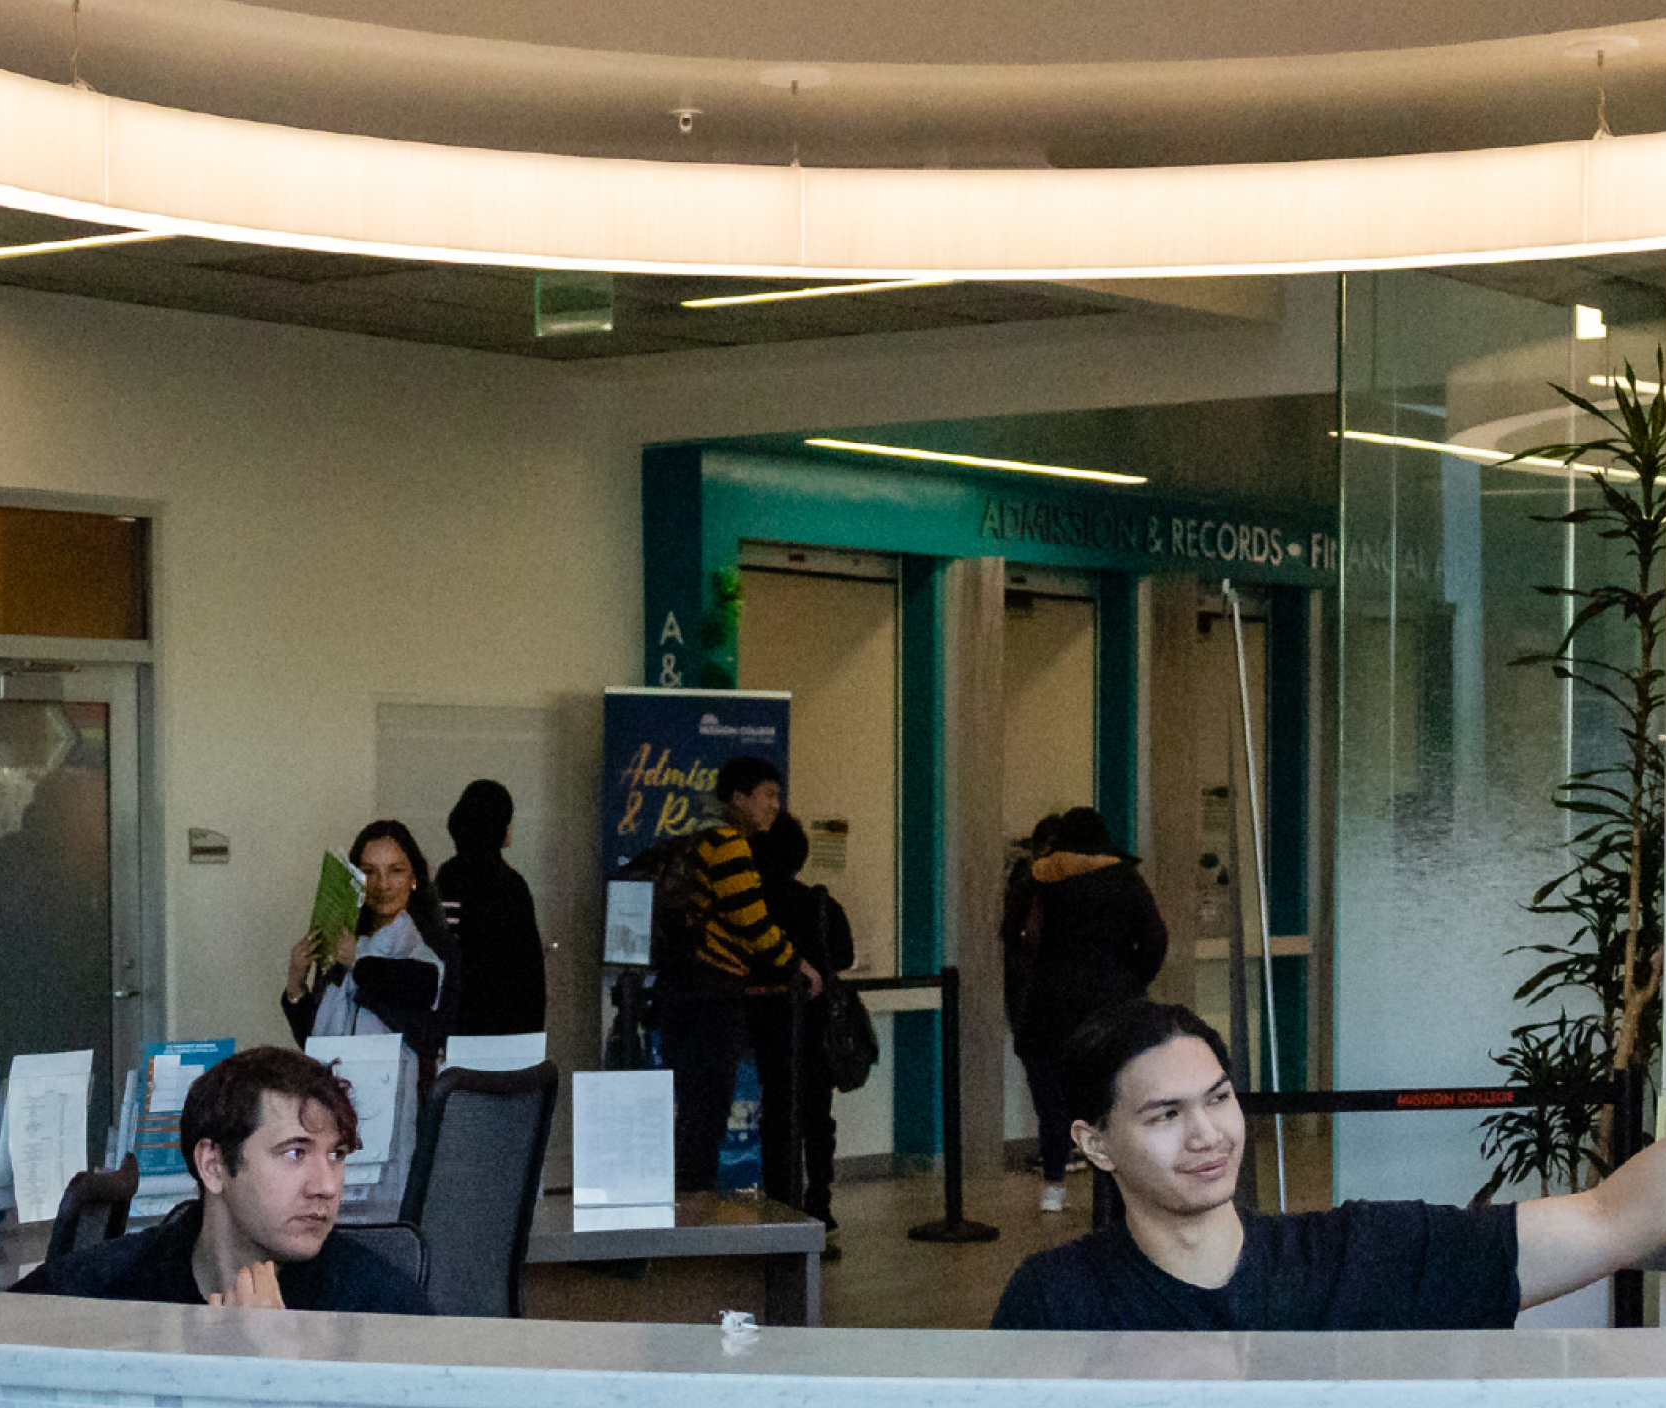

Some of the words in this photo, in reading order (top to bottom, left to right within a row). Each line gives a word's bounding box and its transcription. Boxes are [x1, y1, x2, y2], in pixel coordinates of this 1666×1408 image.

[1147, 516, 1163, 553] &
[1171, 517, 1284, 569] RECORDS
[659, 610, 685, 647] A
[659, 653, 683, 687] &
[616, 791, 644, 837] &
[1396, 1091, 1455, 1106] MISSION
[1457, 1089, 1514, 1104] COLLEGE
